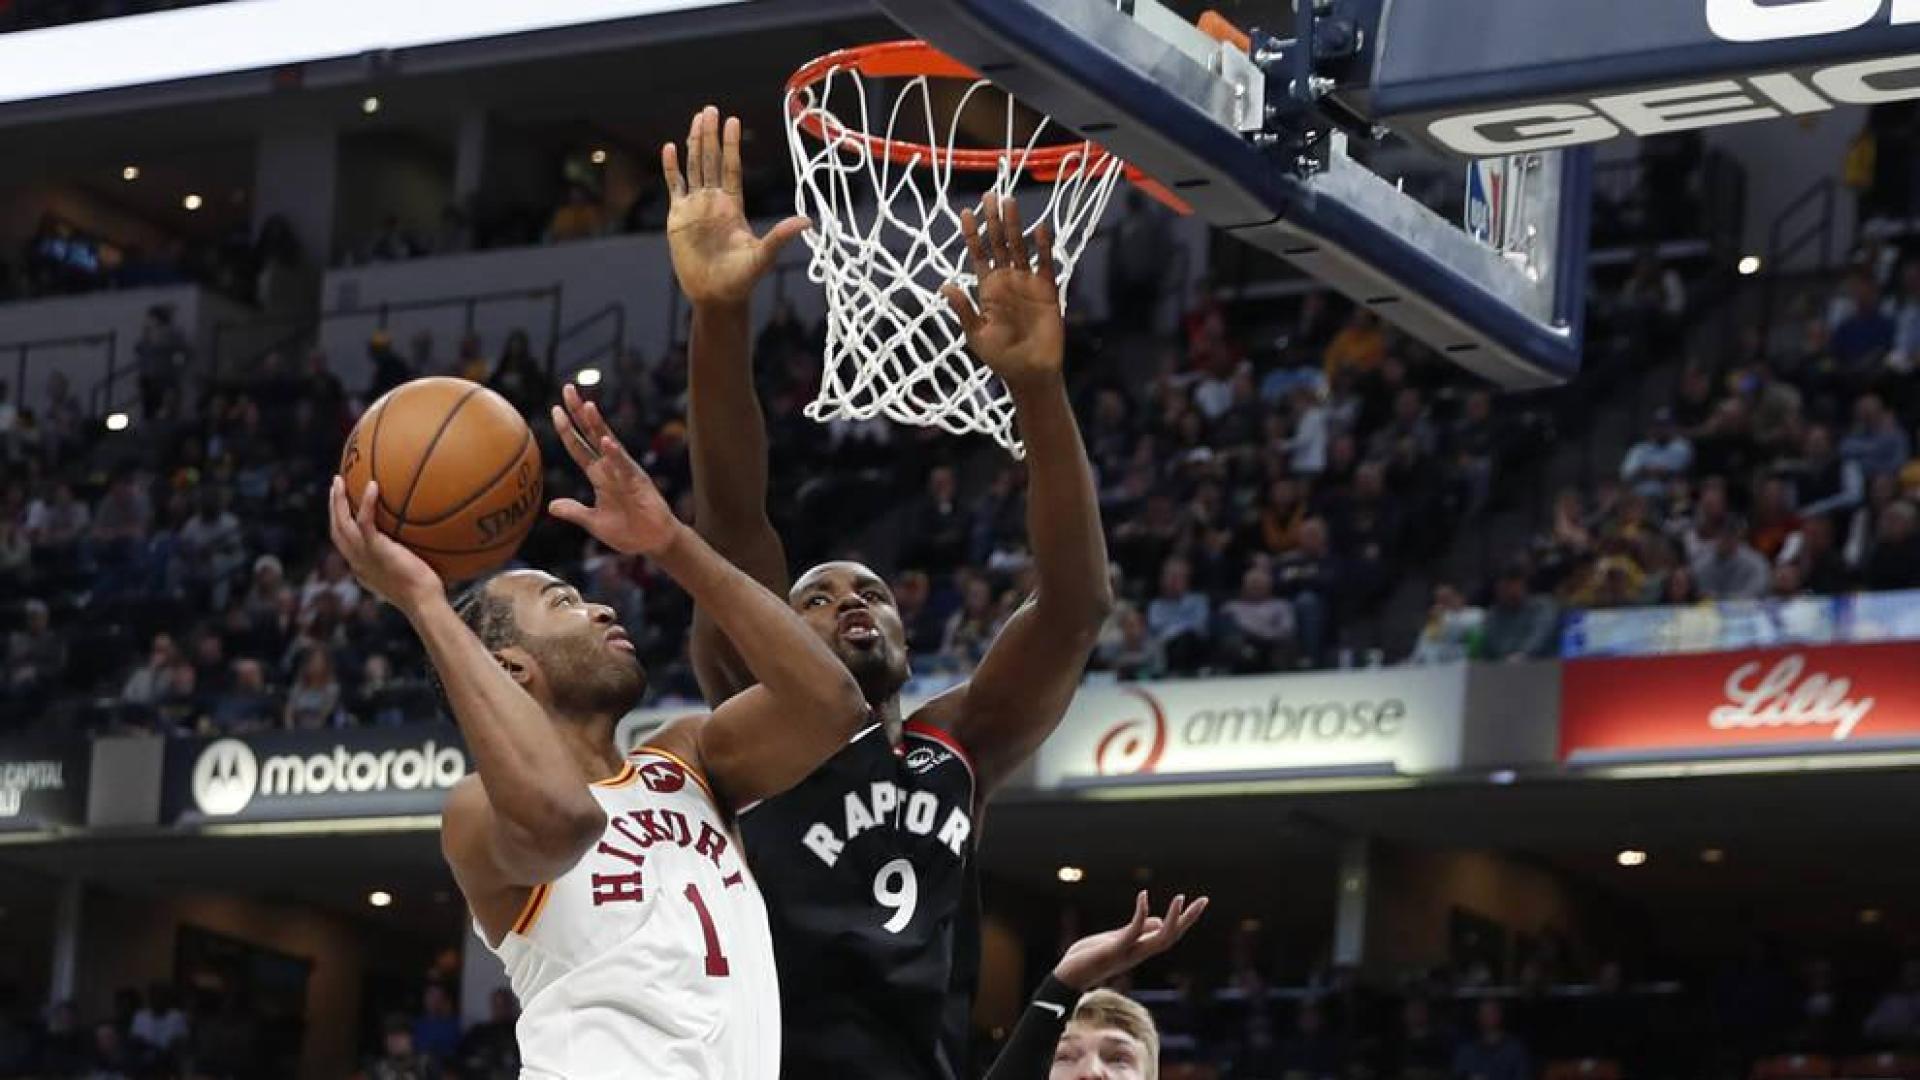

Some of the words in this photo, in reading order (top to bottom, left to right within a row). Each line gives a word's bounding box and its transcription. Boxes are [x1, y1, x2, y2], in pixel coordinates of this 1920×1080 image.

[1181, 692, 1406, 747] ambrose
[1708, 654, 1876, 742] Lilly
[261, 740, 466, 796] motorola
[684, 883, 730, 978] 1
[873, 858, 918, 934] 9
